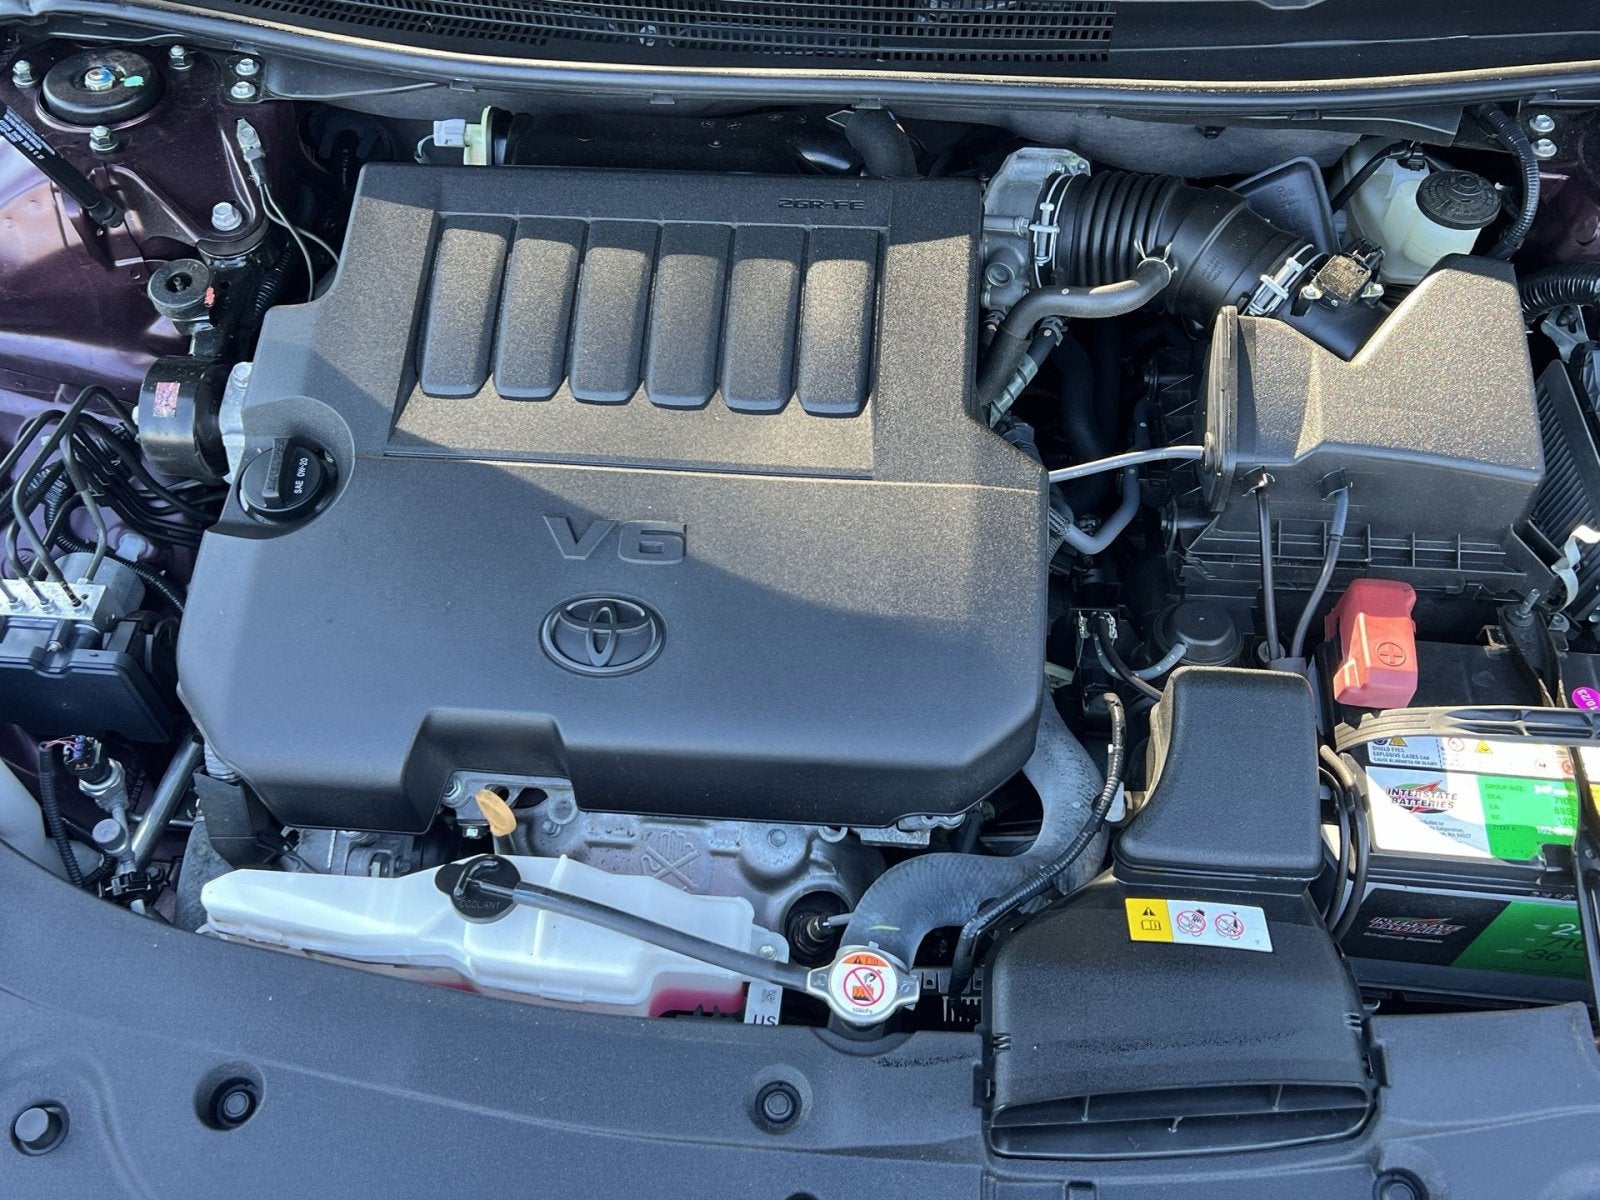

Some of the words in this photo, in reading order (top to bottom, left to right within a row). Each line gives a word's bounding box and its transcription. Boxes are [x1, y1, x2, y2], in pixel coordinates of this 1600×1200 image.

[778, 197, 865, 210] 2GR-FE
[296, 457, 308, 477] 0W-20
[293, 480, 304, 494] SAE
[542, 515, 687, 565] V6
[1372, 751, 1401, 759] EXPLOSIVE
[1386, 787, 1458, 800] INTERSTATE
[1392, 797, 1454, 808] BATTERIES
[460, 901, 503, 910] COOLANT
[1551, 923, 1582, 936] 2
